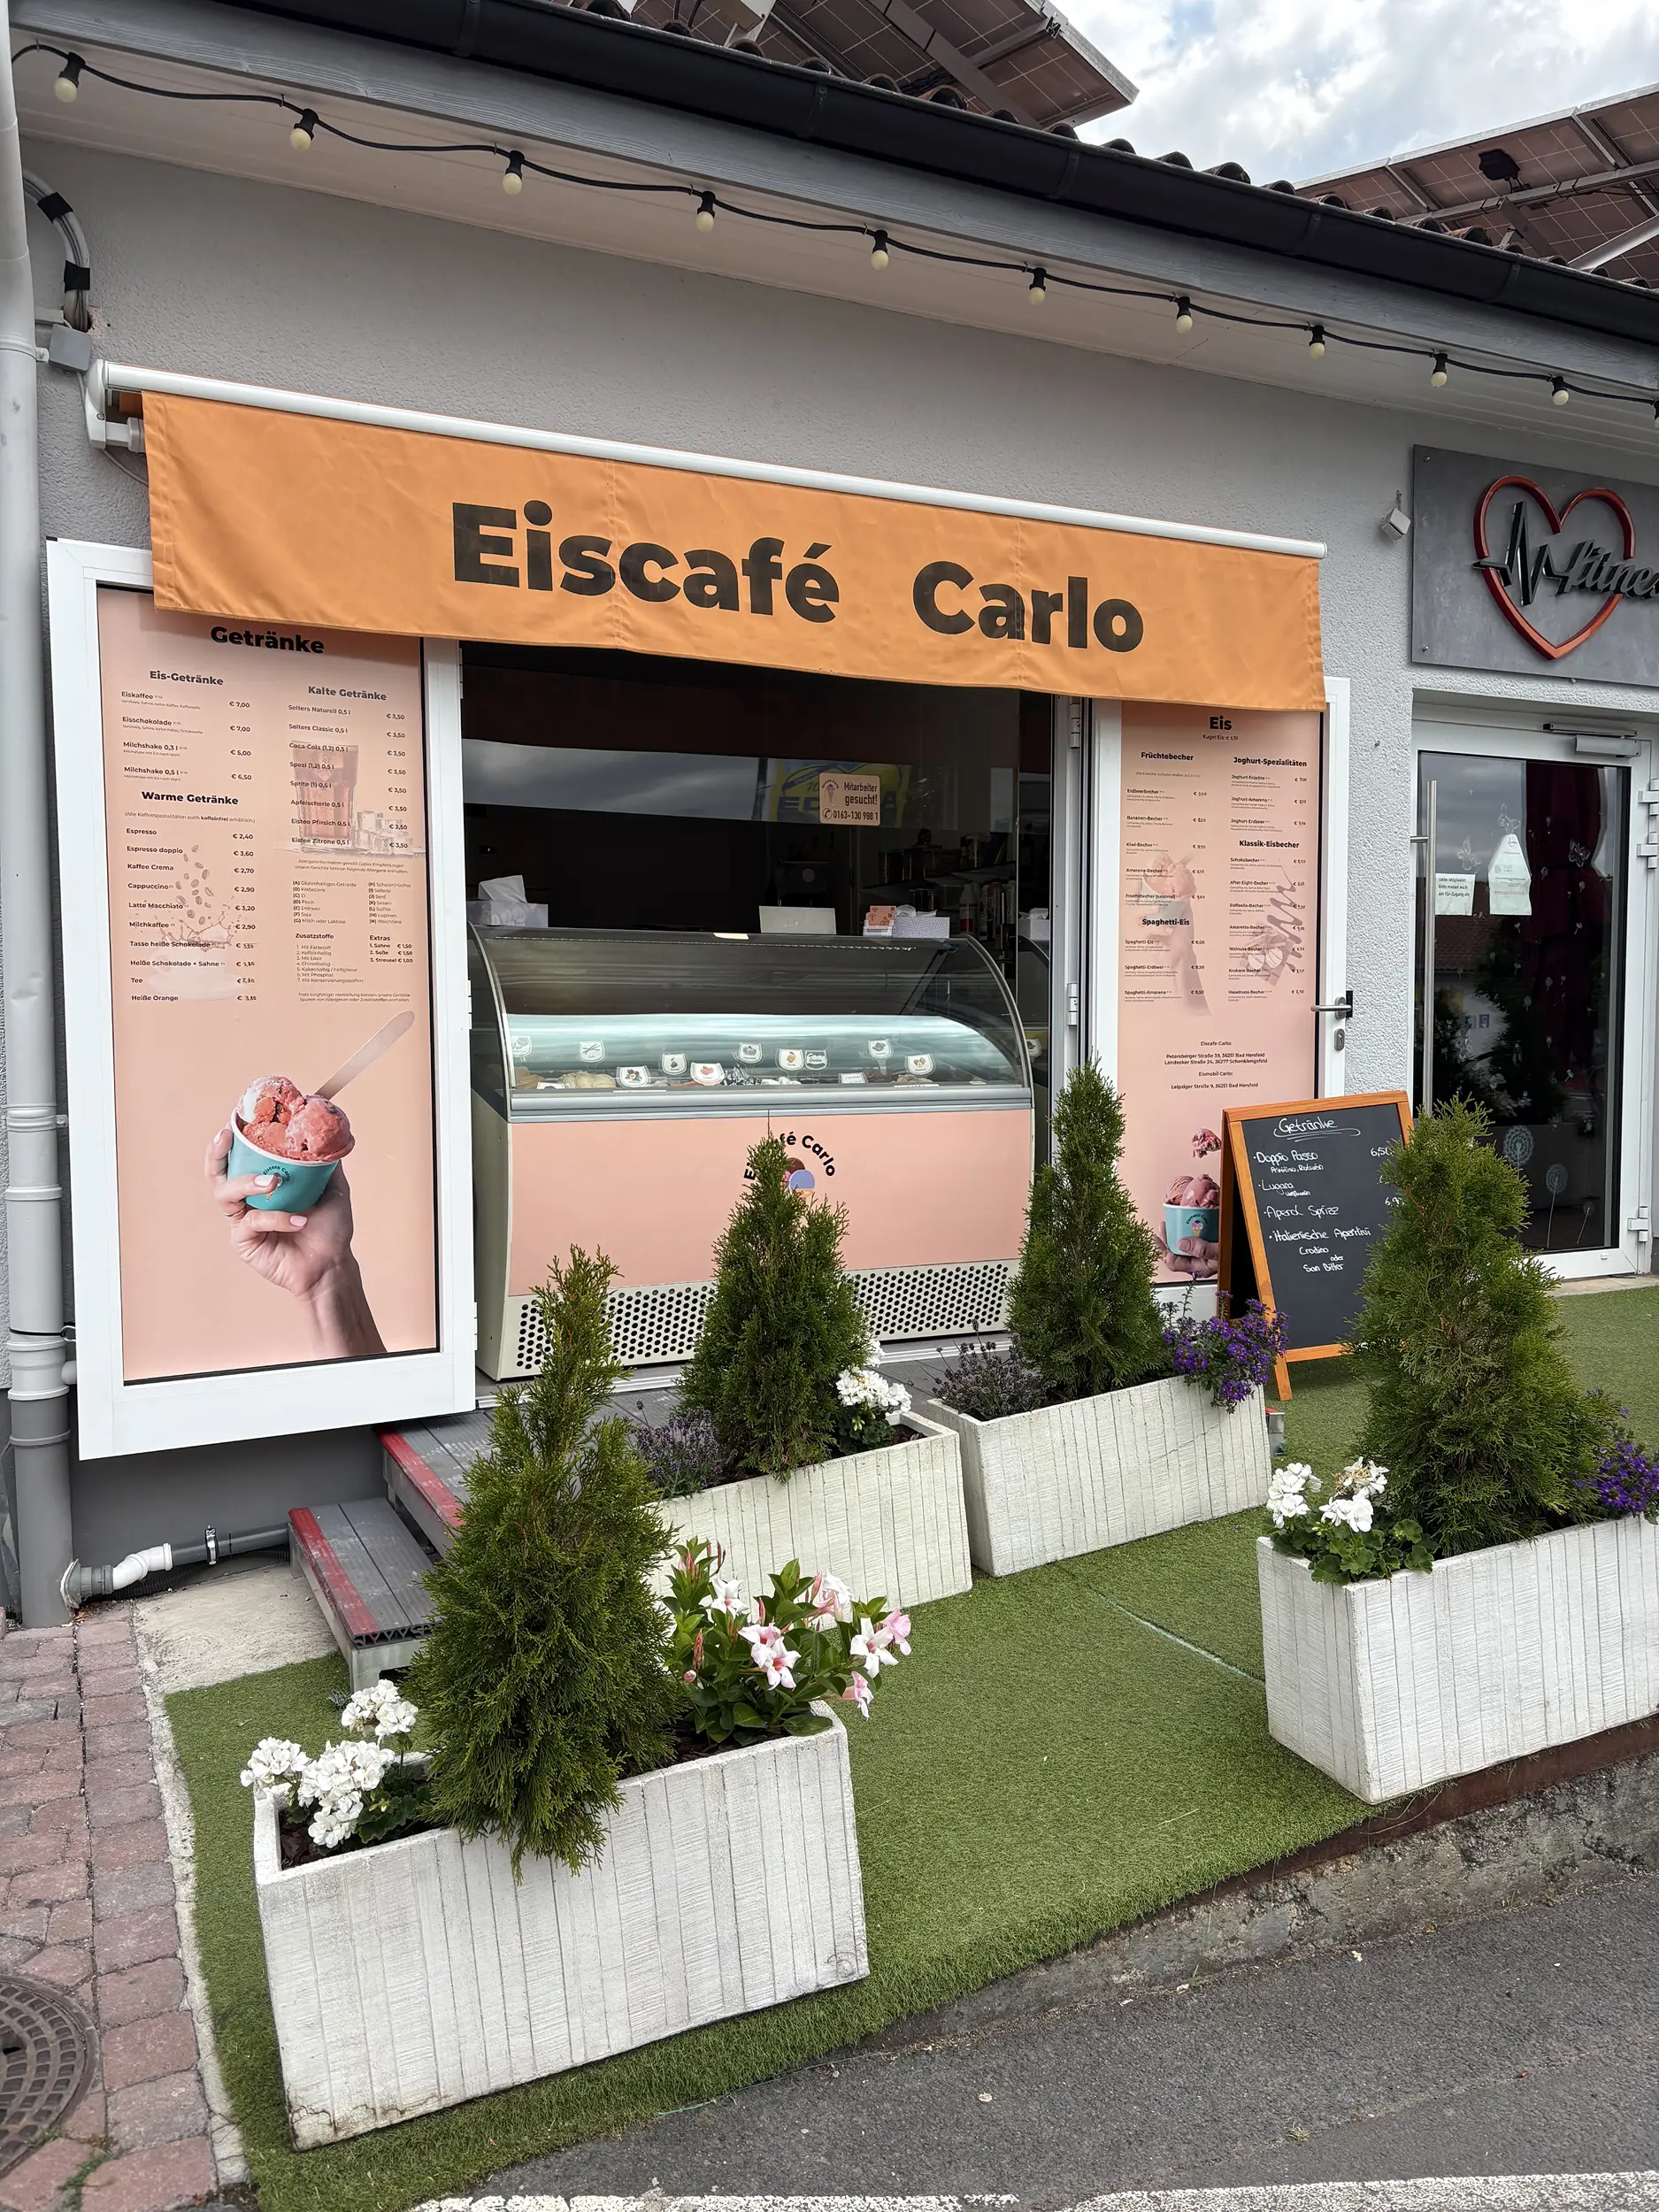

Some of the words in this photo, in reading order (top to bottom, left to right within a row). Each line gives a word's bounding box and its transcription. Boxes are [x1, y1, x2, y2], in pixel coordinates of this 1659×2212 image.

[452, 500, 840, 623] Eiscafé
[912, 560, 1143, 652] Carlo
[211, 626, 325, 653] Getränke
[150, 671, 223, 685] Eis-Getränke
[308, 687, 336, 695] Kalte
[340, 689, 387, 701] Getränke
[123, 717, 172, 726] Eisschokolade
[1210, 715, 1232, 730] Eis
[1233, 757, 1307, 767] Joghurt-Spezialitäten
[844, 782, 877, 793] Mitarbeiter
[142, 791, 183, 802] Warme
[187, 795, 238, 804] Getränke
[845, 795, 877, 806] gesucht!
[833, 810, 861, 820] 0163-130
[1279, 1117, 1337, 1133] Getränke
[802, 1135, 835, 1176] Carlo
[1256, 1152, 1288, 1165] Doppio
[1292, 1150, 1318, 1161] Passo
[1266, 1206, 1303, 1220] Aperol
[1299, 1246, 1329, 1255] Crodino
[1303, 1263, 1320, 1272] San
